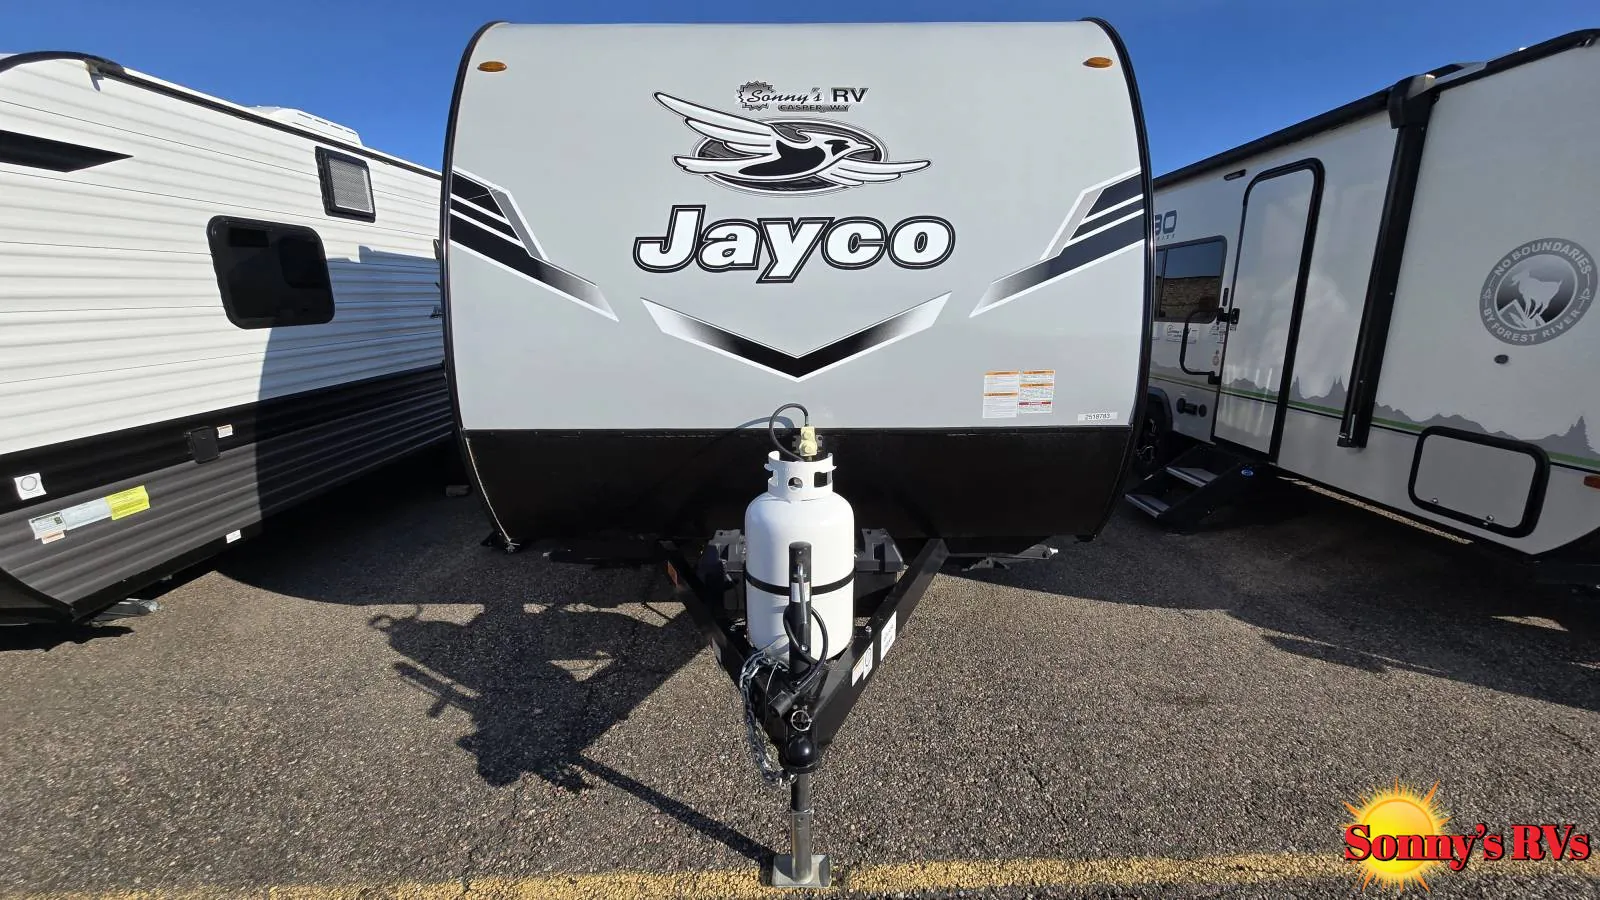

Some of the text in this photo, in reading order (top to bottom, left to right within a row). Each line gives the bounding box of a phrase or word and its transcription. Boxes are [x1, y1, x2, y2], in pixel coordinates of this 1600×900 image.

[747, 87, 869, 104] Sonny's RV
[828, 104, 851, 112] WY
[632, 204, 956, 284] Jayco
[1494, 241, 1593, 276] NO BOUNDARIES
[1483, 308, 1581, 342] BY FOREST RIVER
